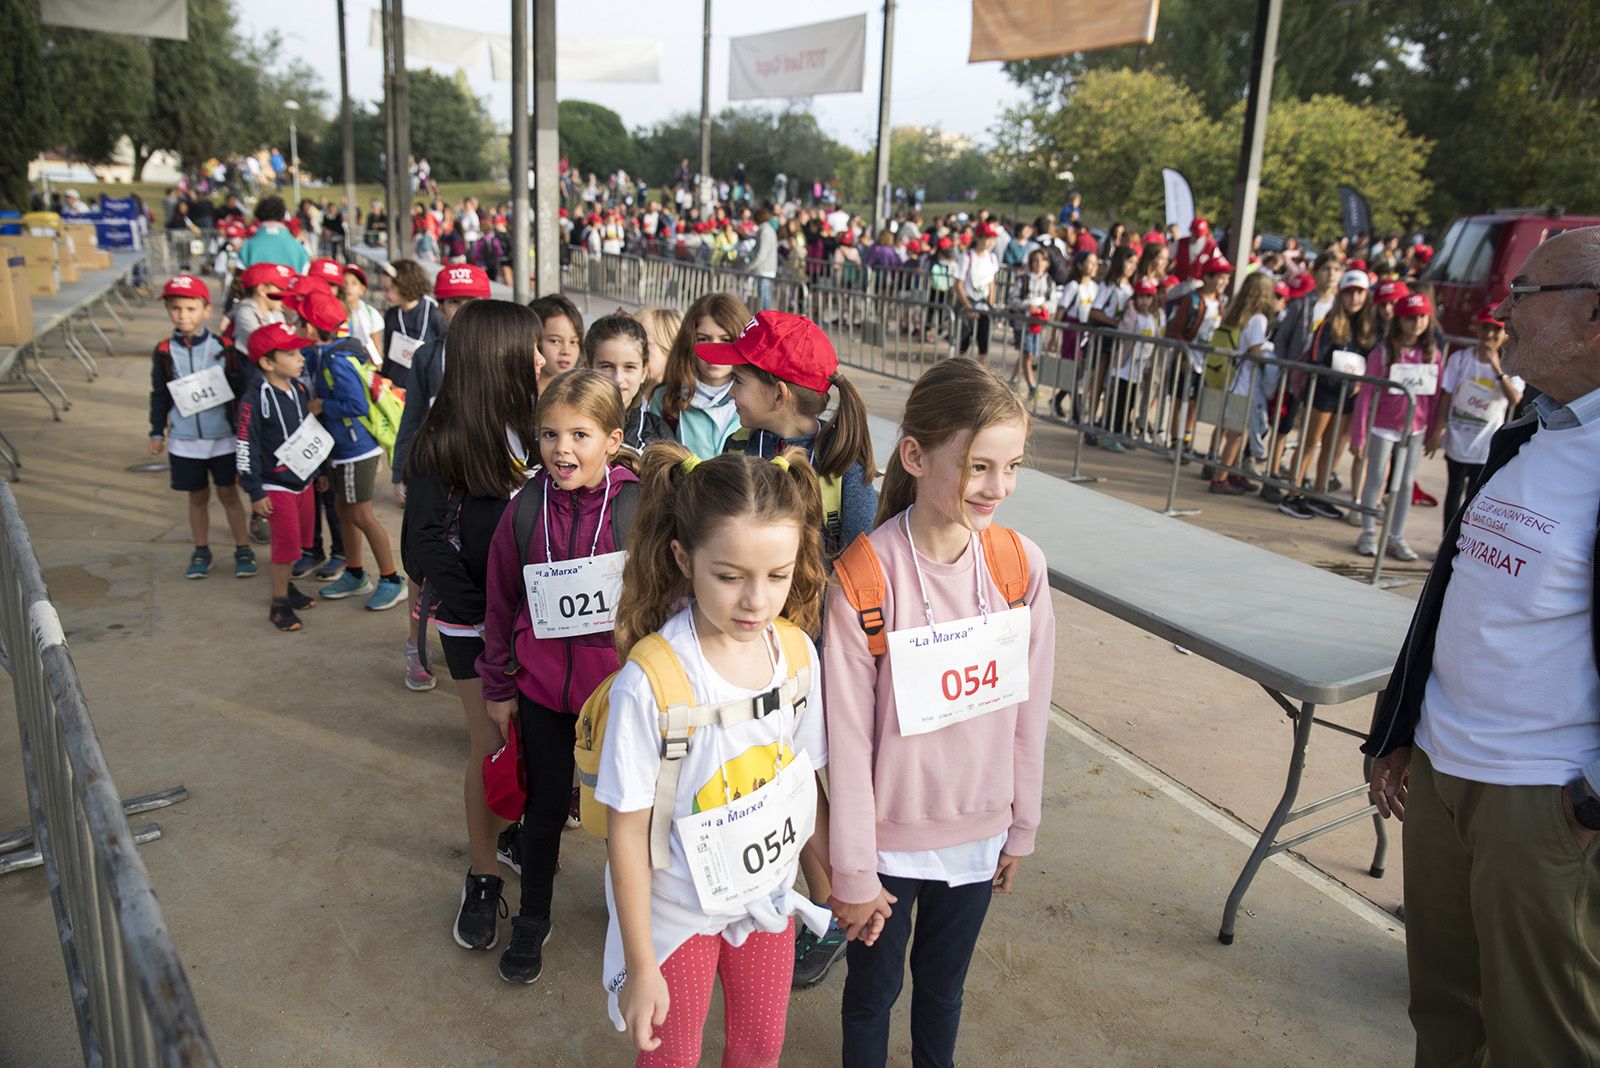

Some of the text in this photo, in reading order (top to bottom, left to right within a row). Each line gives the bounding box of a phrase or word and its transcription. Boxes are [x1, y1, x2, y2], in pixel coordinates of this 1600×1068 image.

[448, 268, 472, 279] TOT
[191, 386, 217, 403] 041
[235, 440, 251, 474] RUSH
[302, 436, 324, 460] 039
[559, 590, 610, 618] 021
[941, 660, 999, 701] 054
[742, 816, 797, 875] 054
